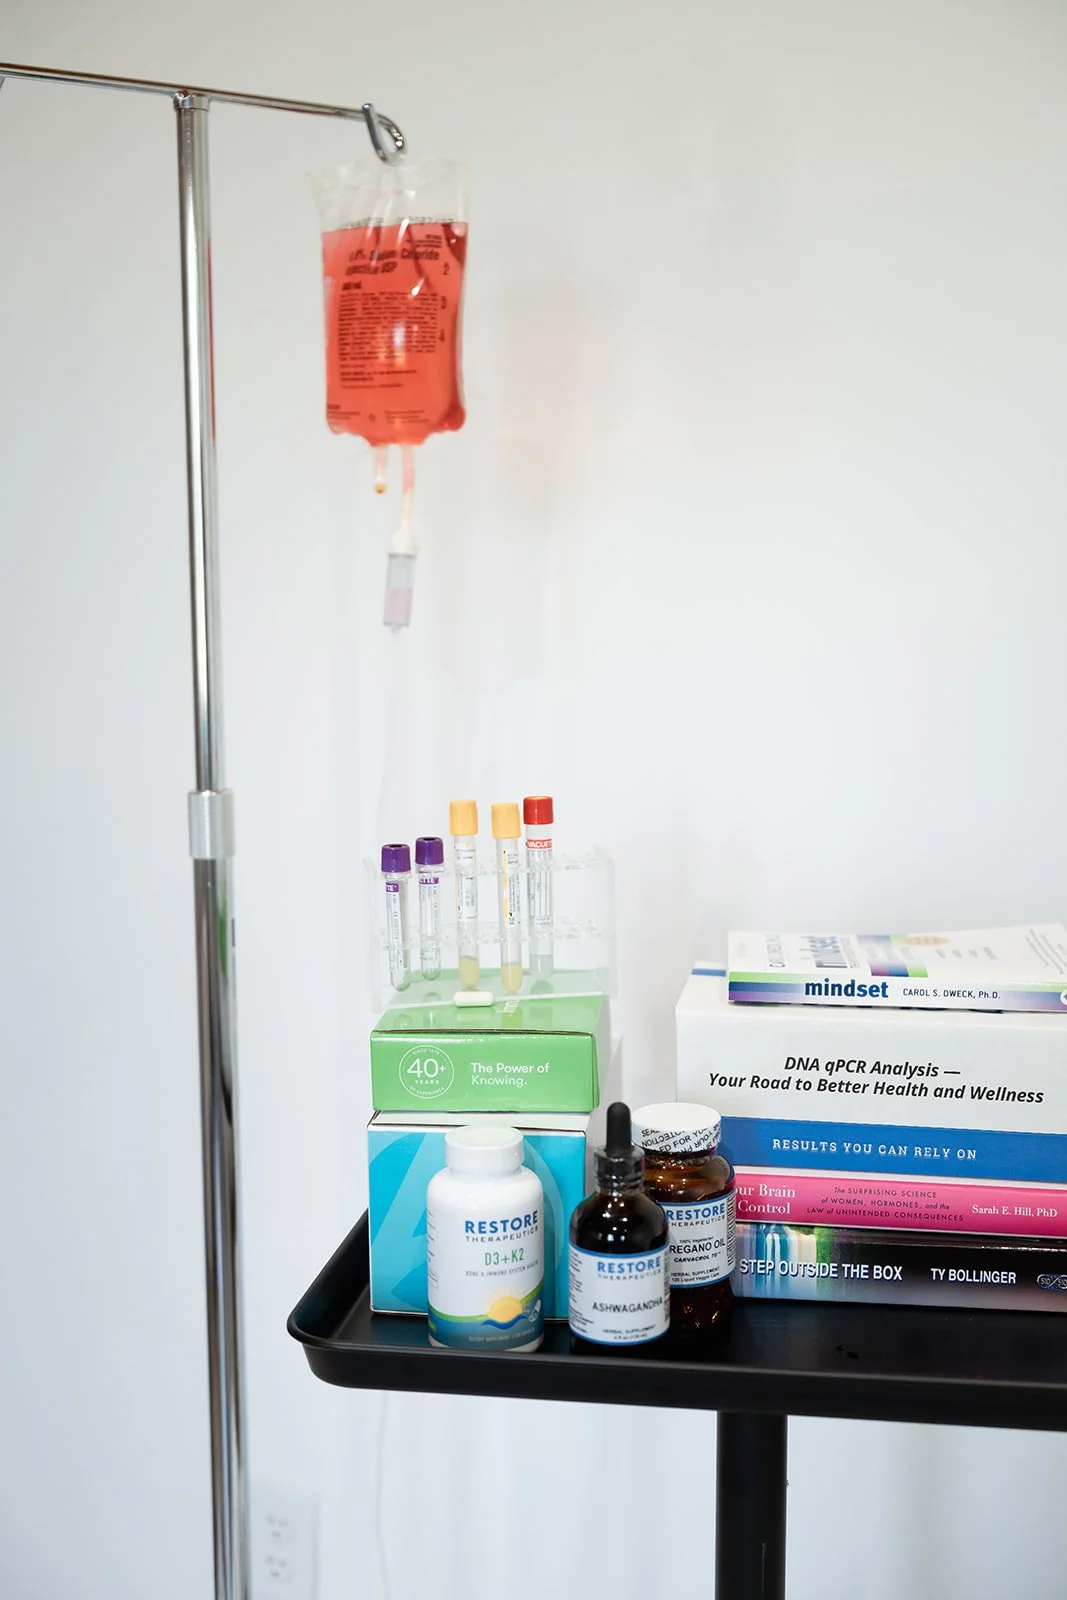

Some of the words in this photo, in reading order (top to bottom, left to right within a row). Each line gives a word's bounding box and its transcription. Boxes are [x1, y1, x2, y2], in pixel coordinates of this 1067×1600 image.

[805, 978, 889, 998] mindset
[903, 988, 930, 997] CAROL
[944, 990, 976, 1000] DWECK,
[978, 991, 1000, 999] Ph.D.
[407, 1058, 446, 1078] 40+
[470, 1062, 493, 1073] The
[496, 1063, 532, 1073] Power
[536, 1062, 550, 1073] of
[784, 1056, 820, 1072] DNA
[824, 1059, 866, 1076] qPCR
[870, 1060, 939, 1078] Analysis
[472, 1076, 528, 1088] Knowing.
[708, 1072, 746, 1088] Your
[750, 1074, 791, 1090] Road
[796, 1078, 812, 1091] to
[817, 1079, 869, 1094] Better
[873, 1081, 929, 1098] Health
[933, 1083, 964, 1098] and
[969, 1087, 1044, 1103] Wellness
[642, 1128, 660, 1137] SEA
[673, 1135, 691, 1148] FOR
[773, 1138, 837, 1152] RESULTS
[843, 1142, 873, 1154] YOU
[878, 1144, 908, 1156] CAN
[914, 1146, 951, 1159] RELY
[956, 1149, 977, 1160] ON
[758, 1184, 796, 1198] Brain
[848, 1188, 897, 1196] SURPRISING
[738, 1200, 791, 1214] Control
[831, 1198, 866, 1206] WOMEN,
[870, 1200, 922, 1208] HORMONES,
[666, 1203, 724, 1220] RESTORE
[836, 1208, 890, 1218] UNINTENDED
[894, 1212, 964, 1221] CONSEQUENCES
[972, 1204, 999, 1215] Sarah
[1002, 1206, 1012, 1215] E.
[1014, 1206, 1034, 1218] Hill,
[1036, 1207, 1058, 1218] PhD
[465, 1210, 538, 1234] RESTORE
[672, 1215, 724, 1227] HERAPEUTICS
[466, 1226, 538, 1242] THERAPEUTICS
[670, 1242, 712, 1254] REGANO
[714, 1238, 726, 1248] OIL
[485, 1248, 524, 1266] D3+K2
[598, 1256, 661, 1274] RESTORE
[739, 1258, 776, 1276] STEP
[778, 1260, 838, 1279] OUTSIDE
[842, 1263, 870, 1278] THE
[872, 1265, 903, 1281] BOX
[930, 1268, 946, 1280] TY
[949, 1269, 1016, 1284] BOLLINGER
[592, 1297, 662, 1312] ASHWAGANDHA
